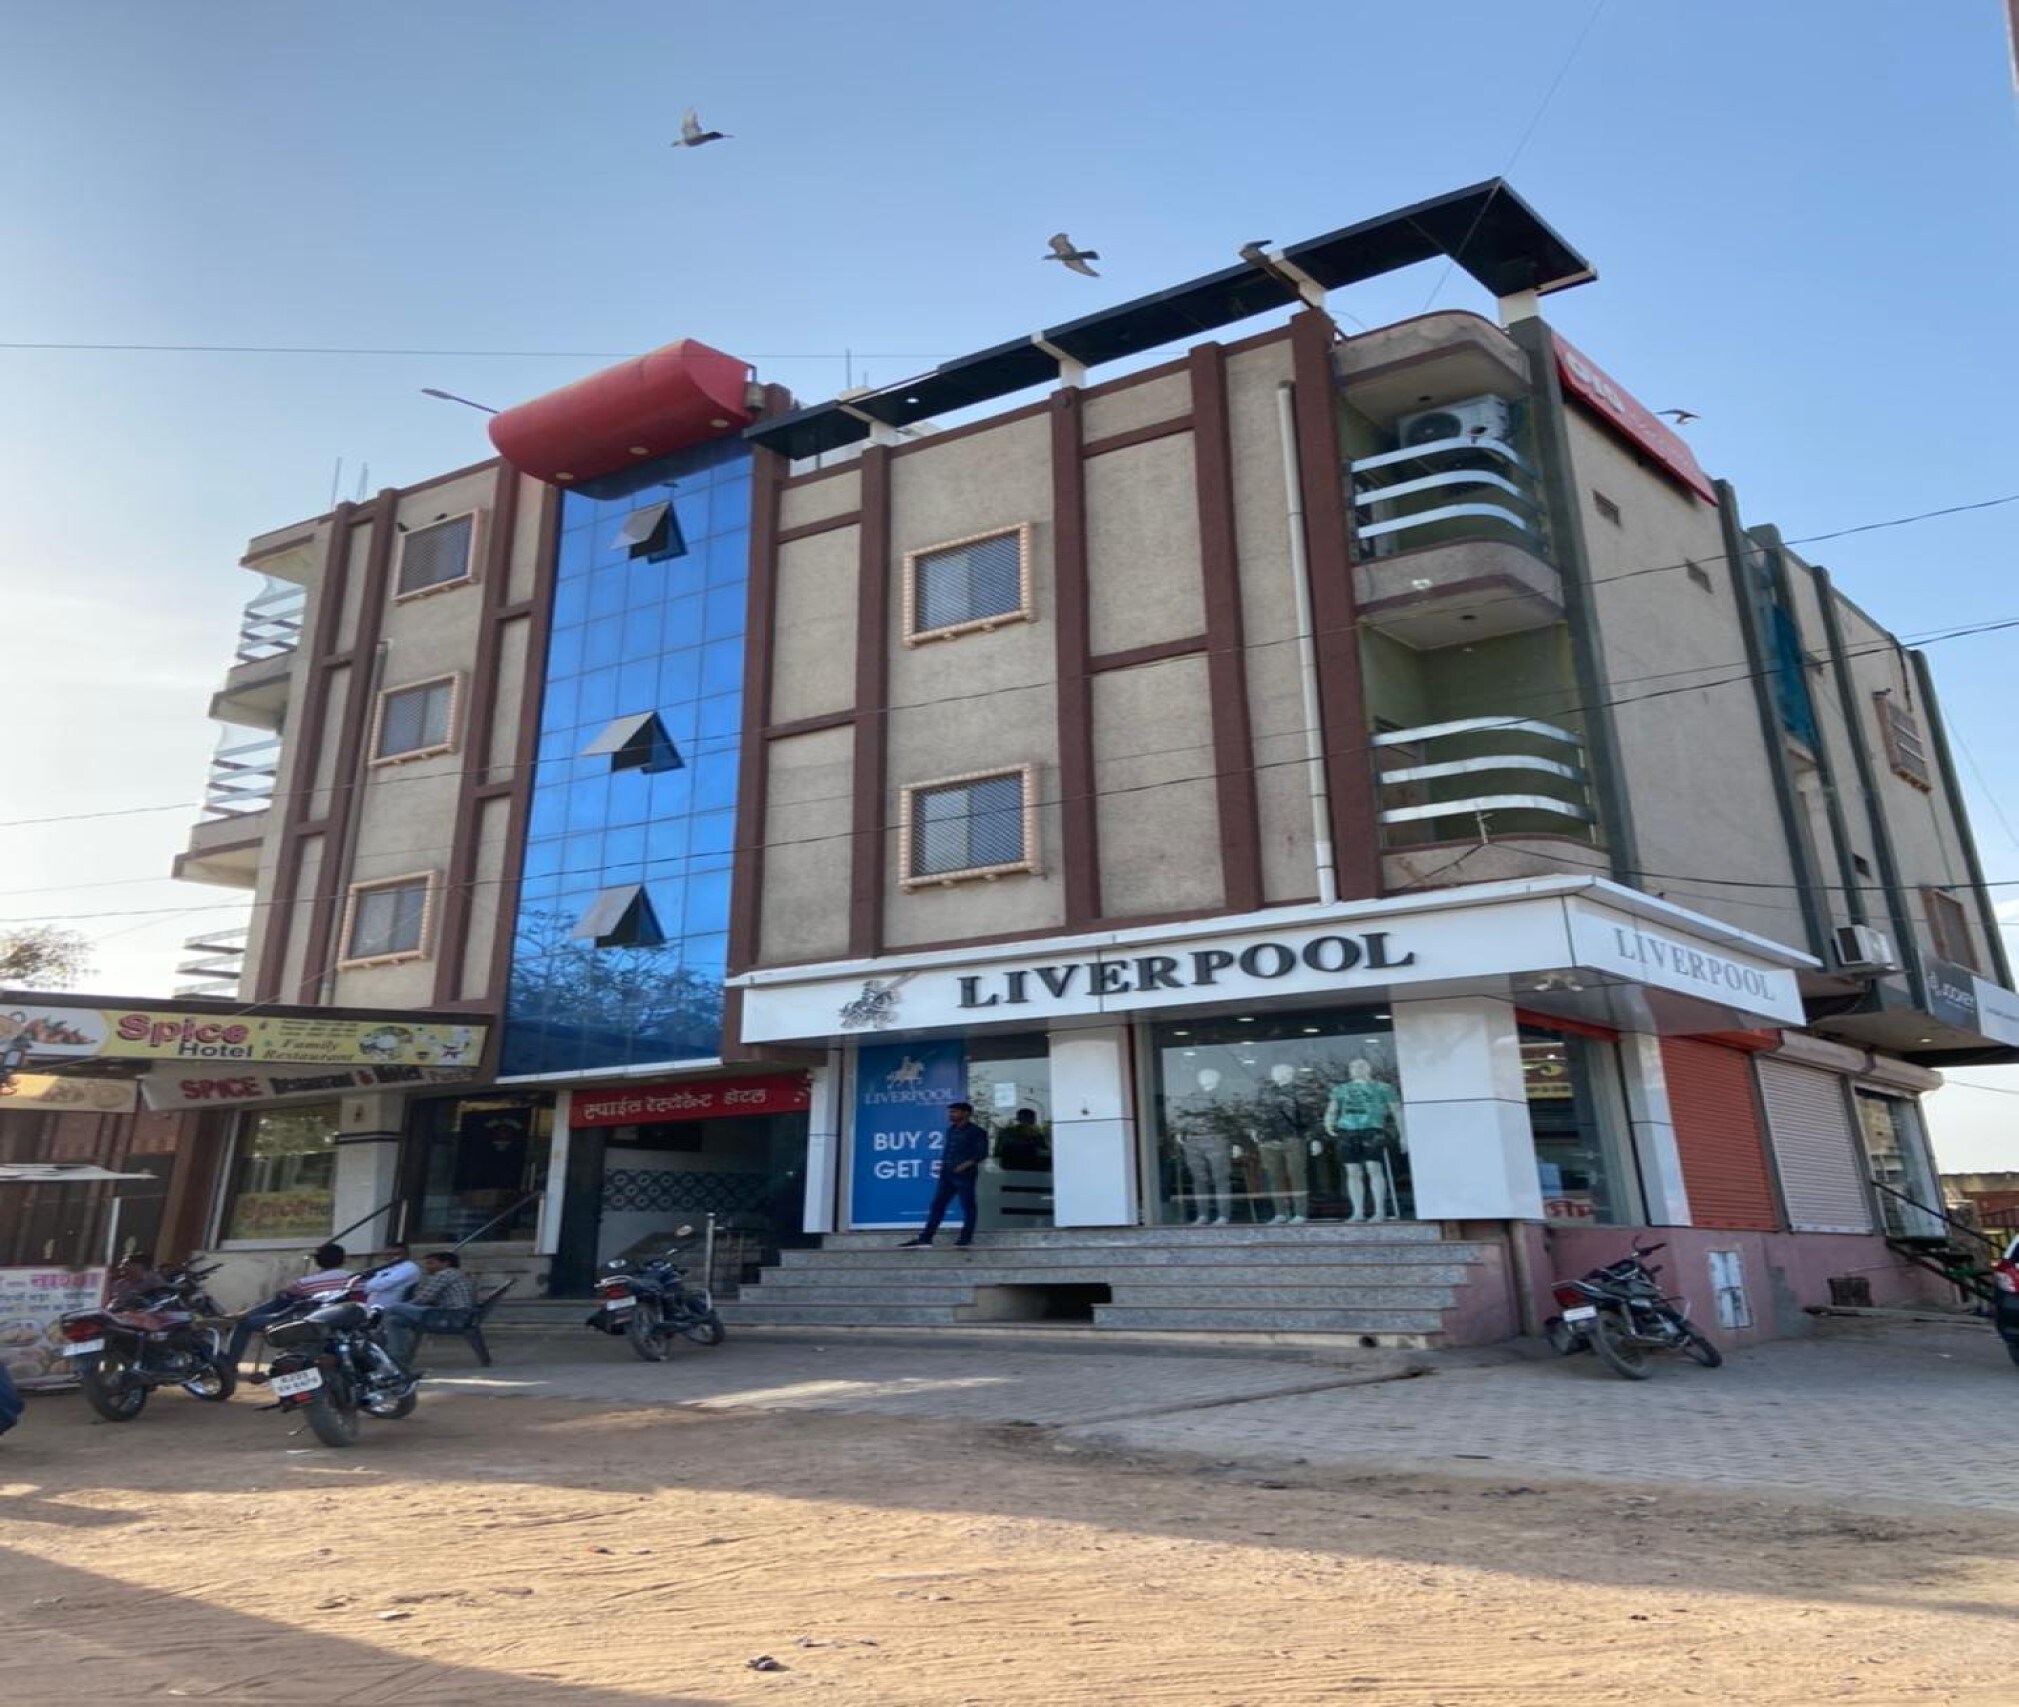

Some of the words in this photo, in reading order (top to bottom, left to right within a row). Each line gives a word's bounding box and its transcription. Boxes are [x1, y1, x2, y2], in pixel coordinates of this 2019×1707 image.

[957, 931, 1415, 1009] LIVERPOOL
[1614, 926, 1777, 1002] LIVERPOOL
[116, 1013, 250, 1048] Spice
[177, 1042, 254, 1058] Hotel
[179, 1075, 264, 1100] SPICE
[864, 1087, 957, 1105] LIVERPOOL
[873, 1130, 922, 1151] BUY
[928, 1130, 944, 1150] 2
[873, 1159, 922, 1180] GET
